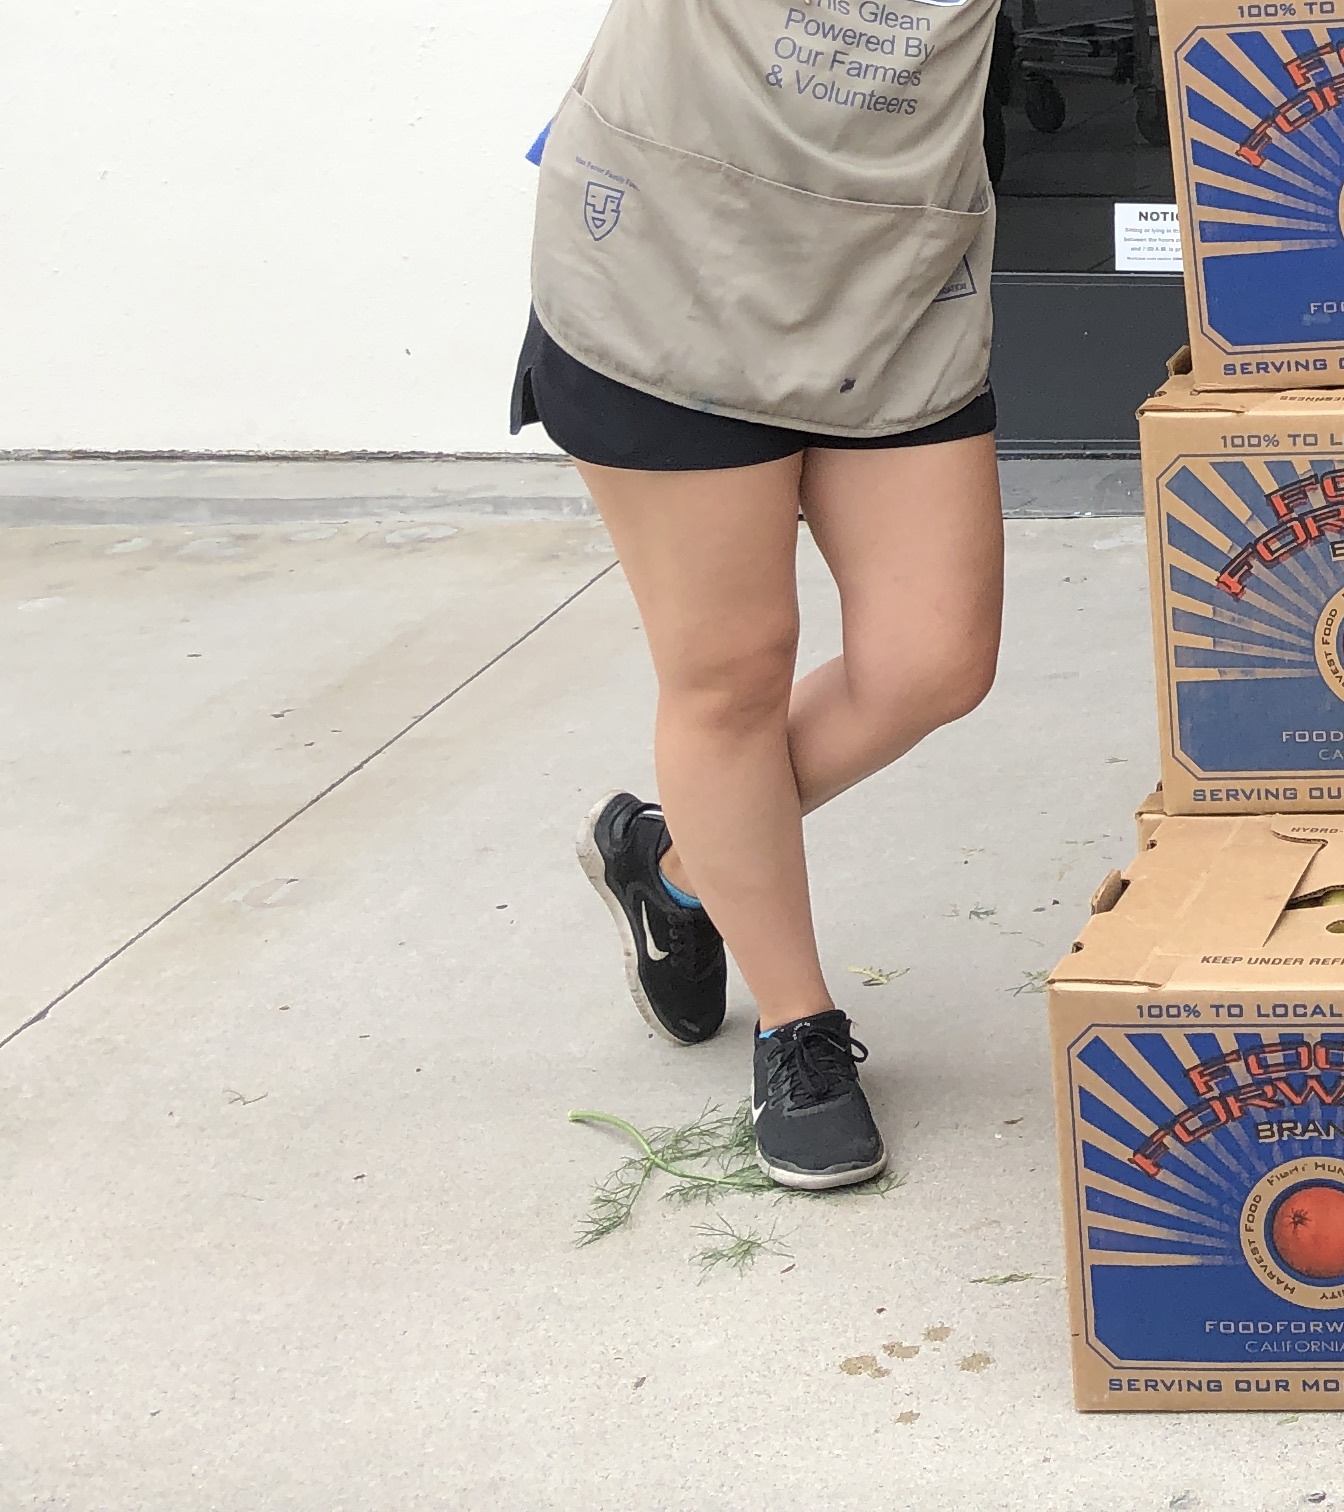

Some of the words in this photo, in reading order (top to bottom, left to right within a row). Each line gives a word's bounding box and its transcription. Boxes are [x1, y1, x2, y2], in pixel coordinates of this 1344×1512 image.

[858, 0, 931, 32] Glean
[1238, 1, 1297, 17] 100%
[1306, 0, 1336, 14] TO
[784, 8, 896, 56] Powered
[904, 36, 936, 66] By
[774, 36, 824, 68] Our
[766, 64, 783, 88] &
[795, 70, 918, 115] Volunteers
[1138, 211, 1179, 222] NOTI
[1200, 954, 1244, 965] KEEP
[1247, 955, 1305, 966] UNDER
[1108, 1378, 1222, 1392] SERVING
[1234, 1378, 1290, 1392] OUR
